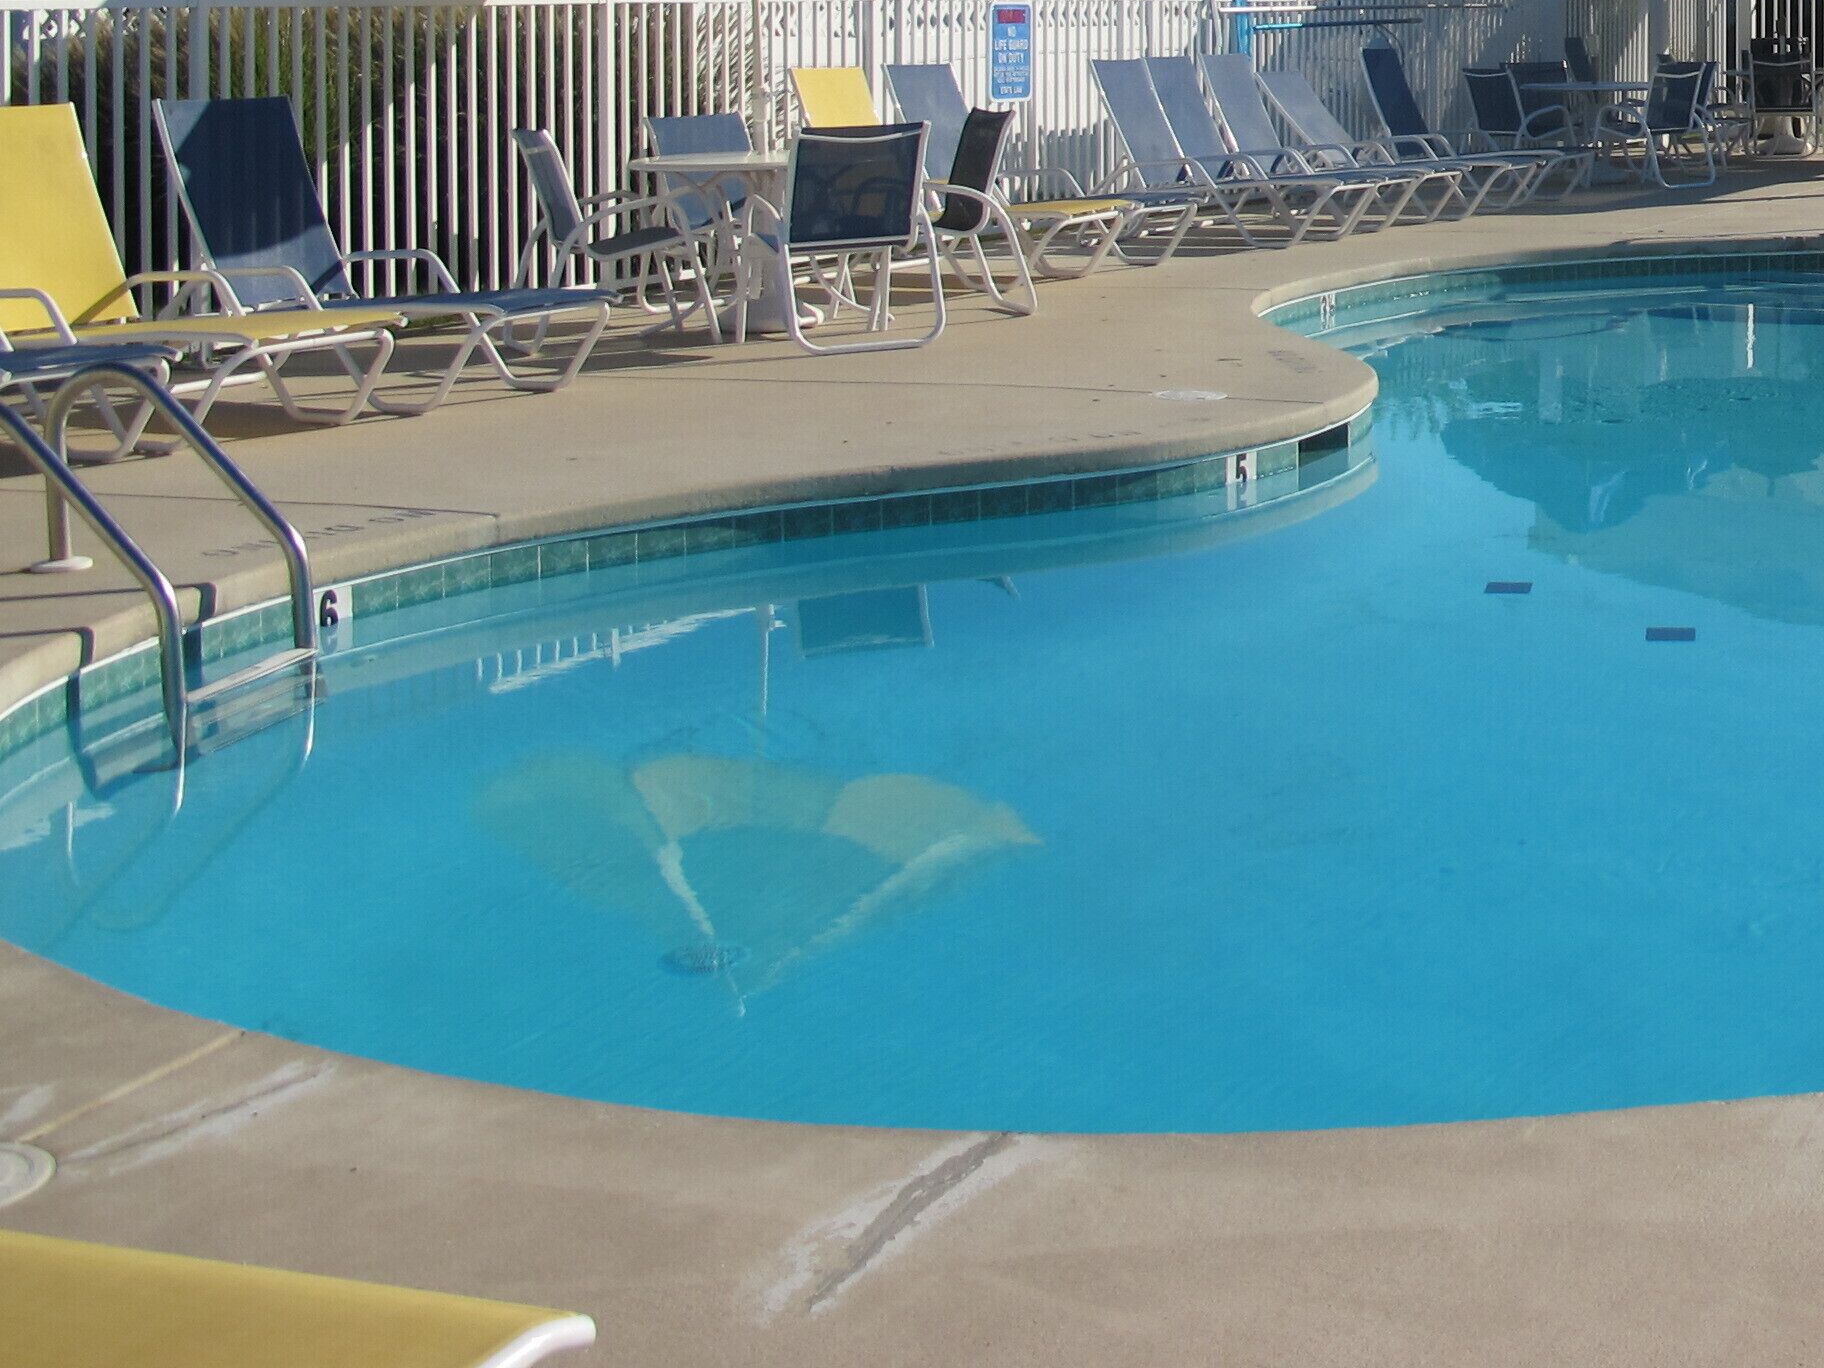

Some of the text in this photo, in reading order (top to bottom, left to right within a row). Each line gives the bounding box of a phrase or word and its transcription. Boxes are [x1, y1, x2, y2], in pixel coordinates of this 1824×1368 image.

[1007, 26, 1016, 37] NO
[994, 38, 1029, 51] LIFE GUARD
[998, 52, 1024, 64] ON DUTY
[1235, 453, 1248, 483] 5
[319, 589, 339, 627] 6
